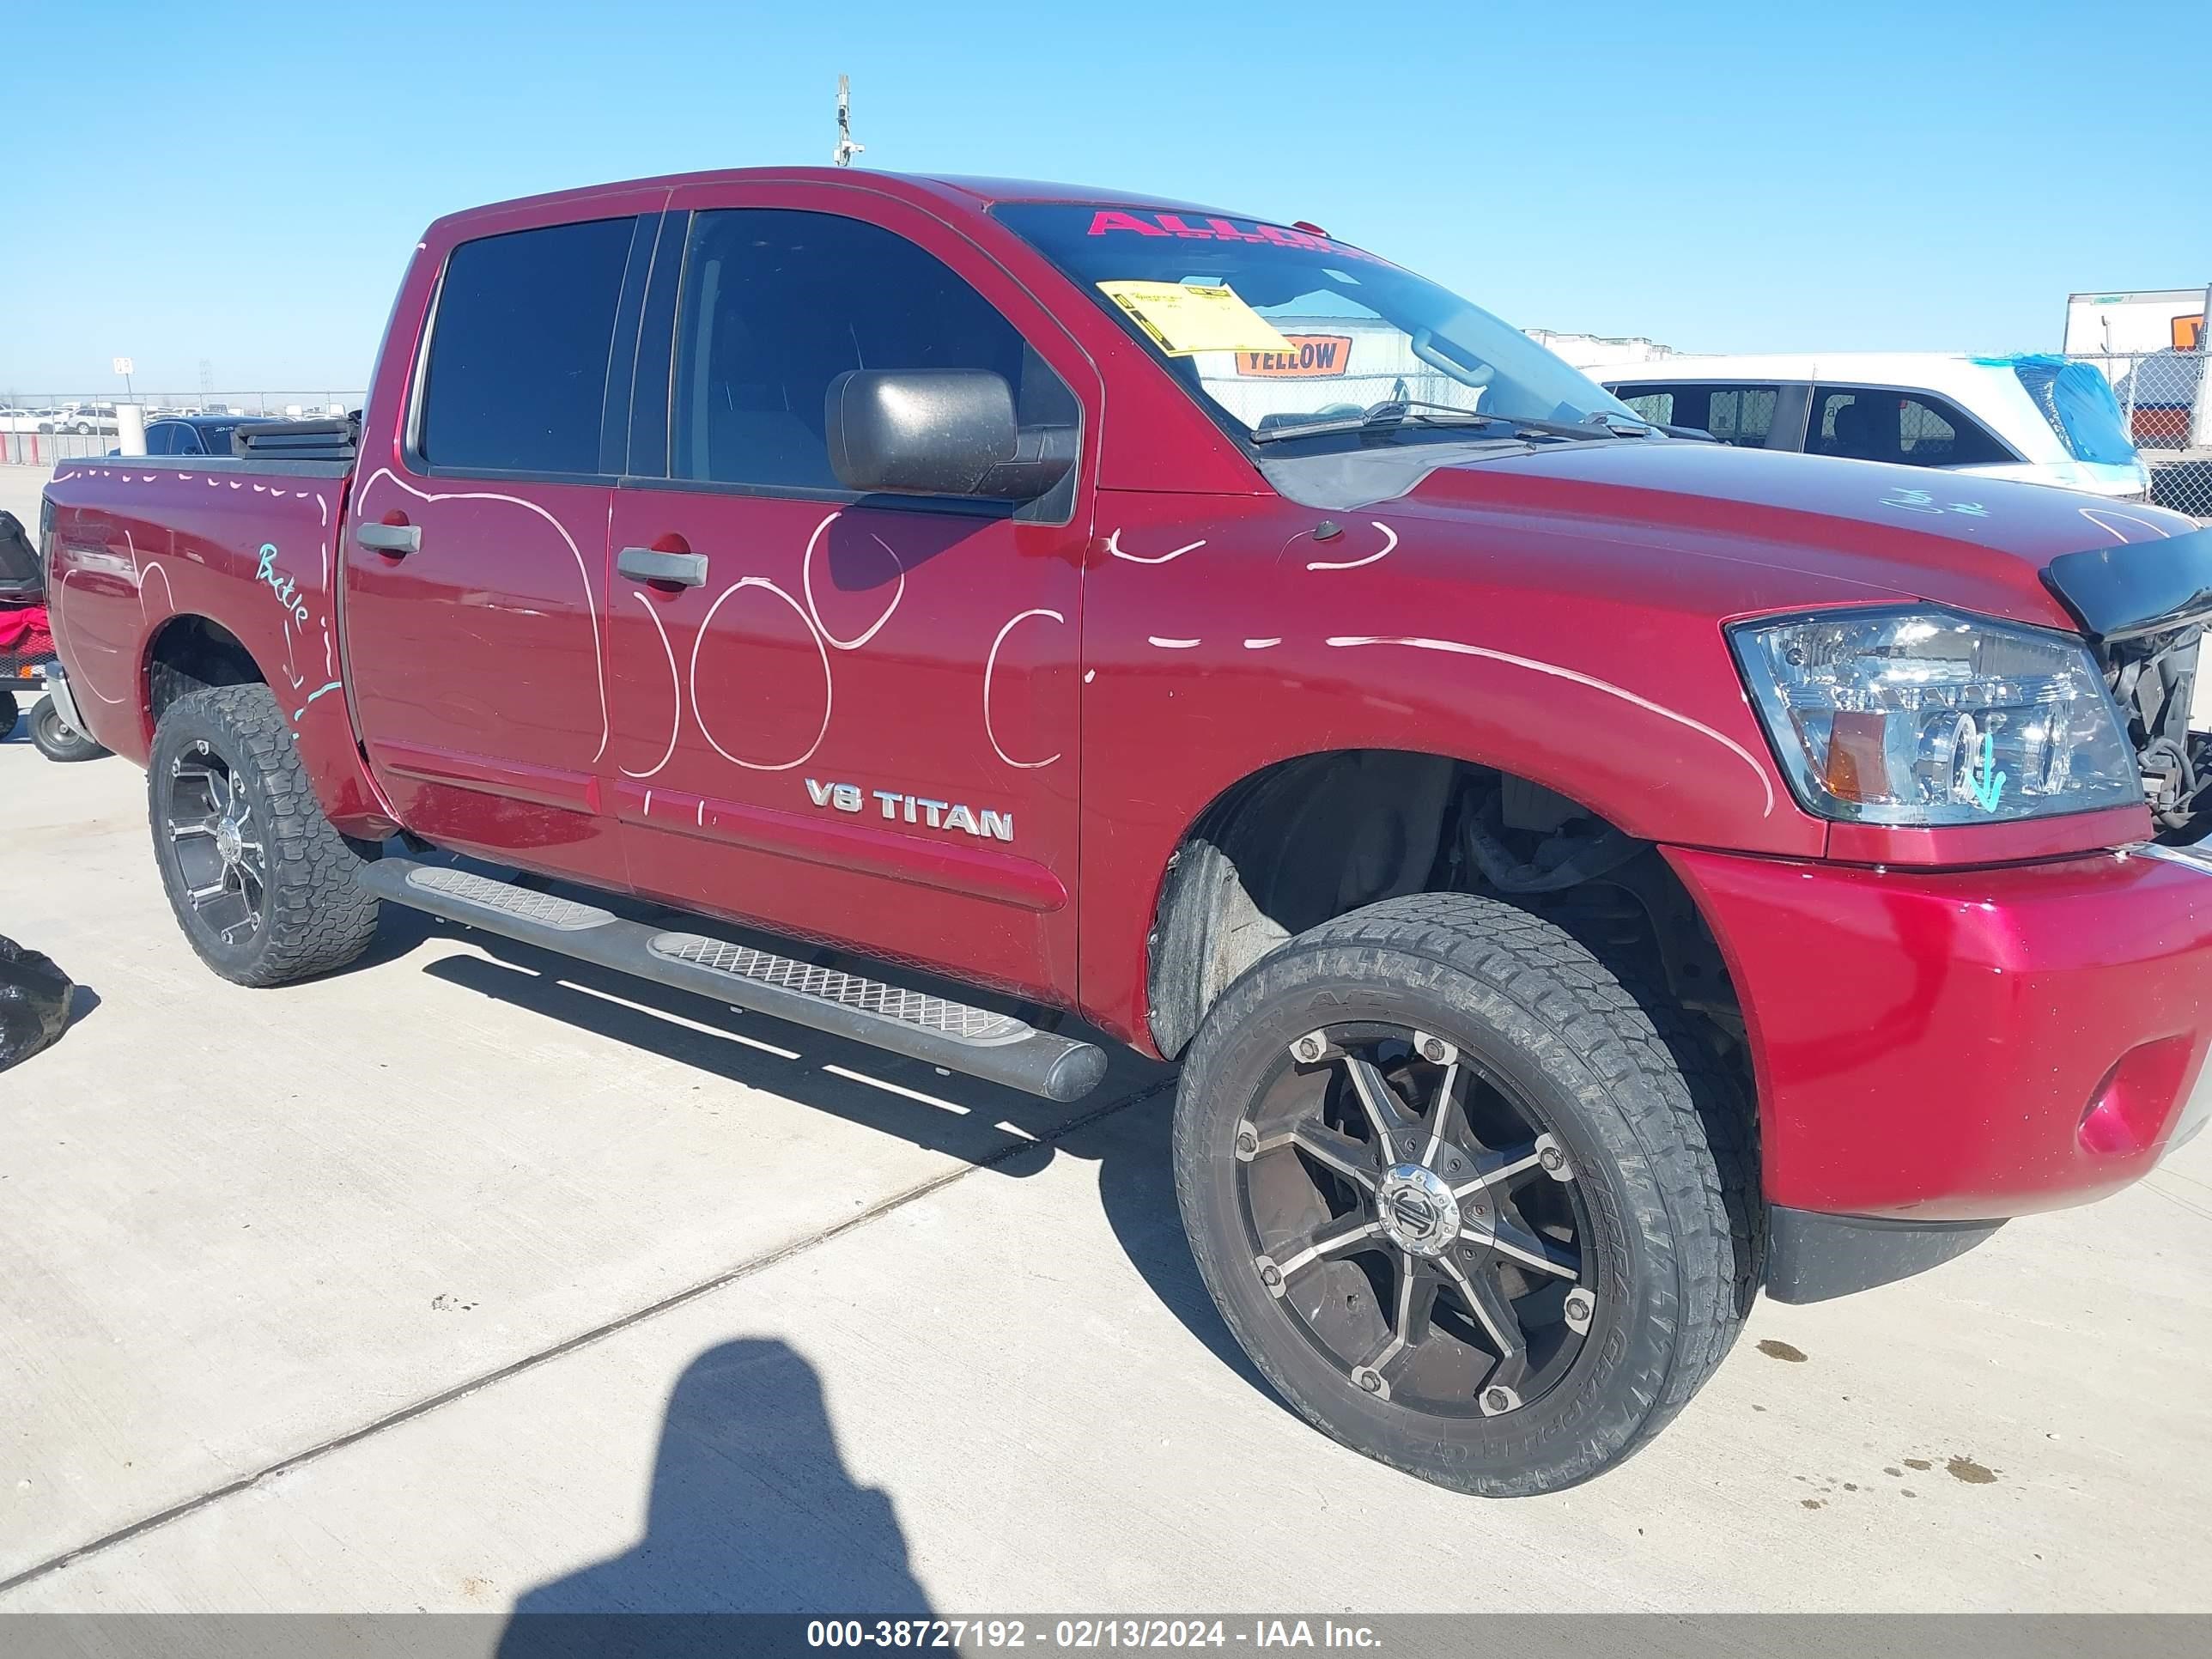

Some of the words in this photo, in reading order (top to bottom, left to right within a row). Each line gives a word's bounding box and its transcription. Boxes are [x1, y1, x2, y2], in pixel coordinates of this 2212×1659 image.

[1249, 343, 1337, 369] YELLOW
[804, 777, 863, 813] V8
[872, 789, 1013, 842] TITAN
